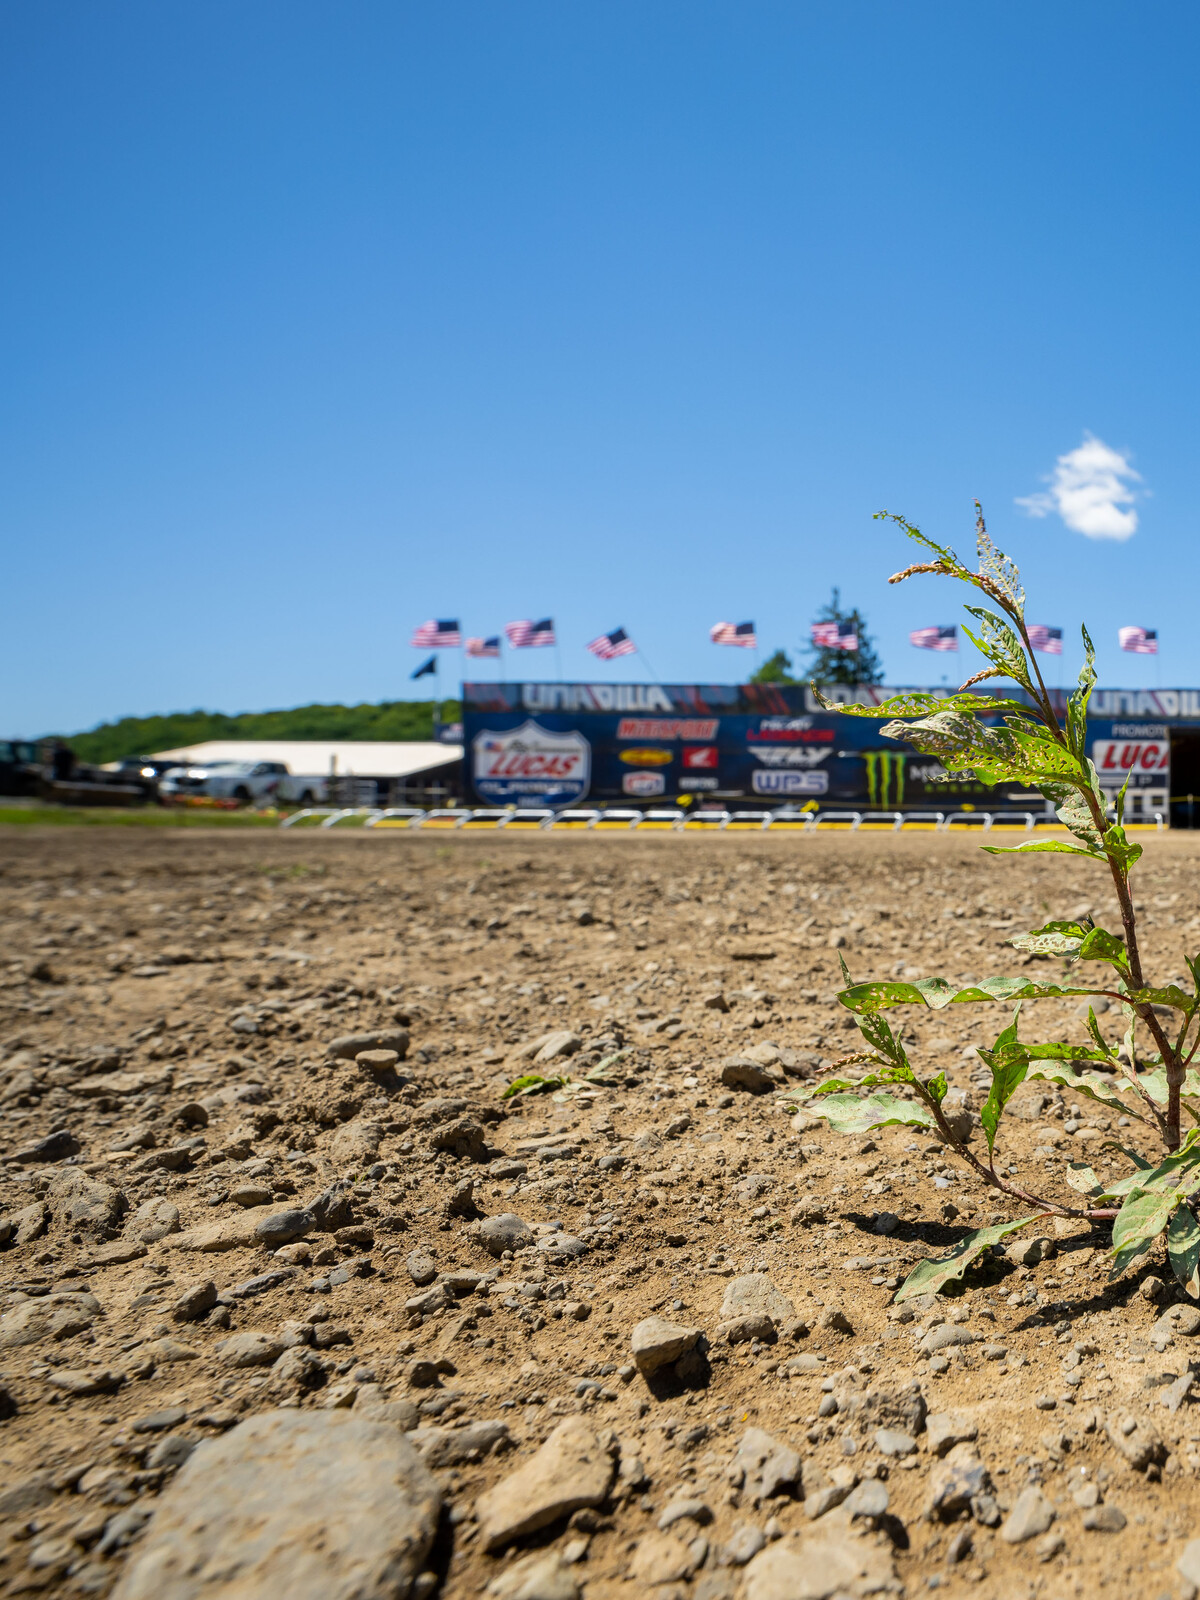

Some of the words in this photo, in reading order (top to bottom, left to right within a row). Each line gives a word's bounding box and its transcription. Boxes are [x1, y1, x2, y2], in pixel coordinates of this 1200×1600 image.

[521, 684, 674, 711] UNADILLA
[488, 753, 580, 777] LUCAS
[755, 773, 826, 791] WPS
